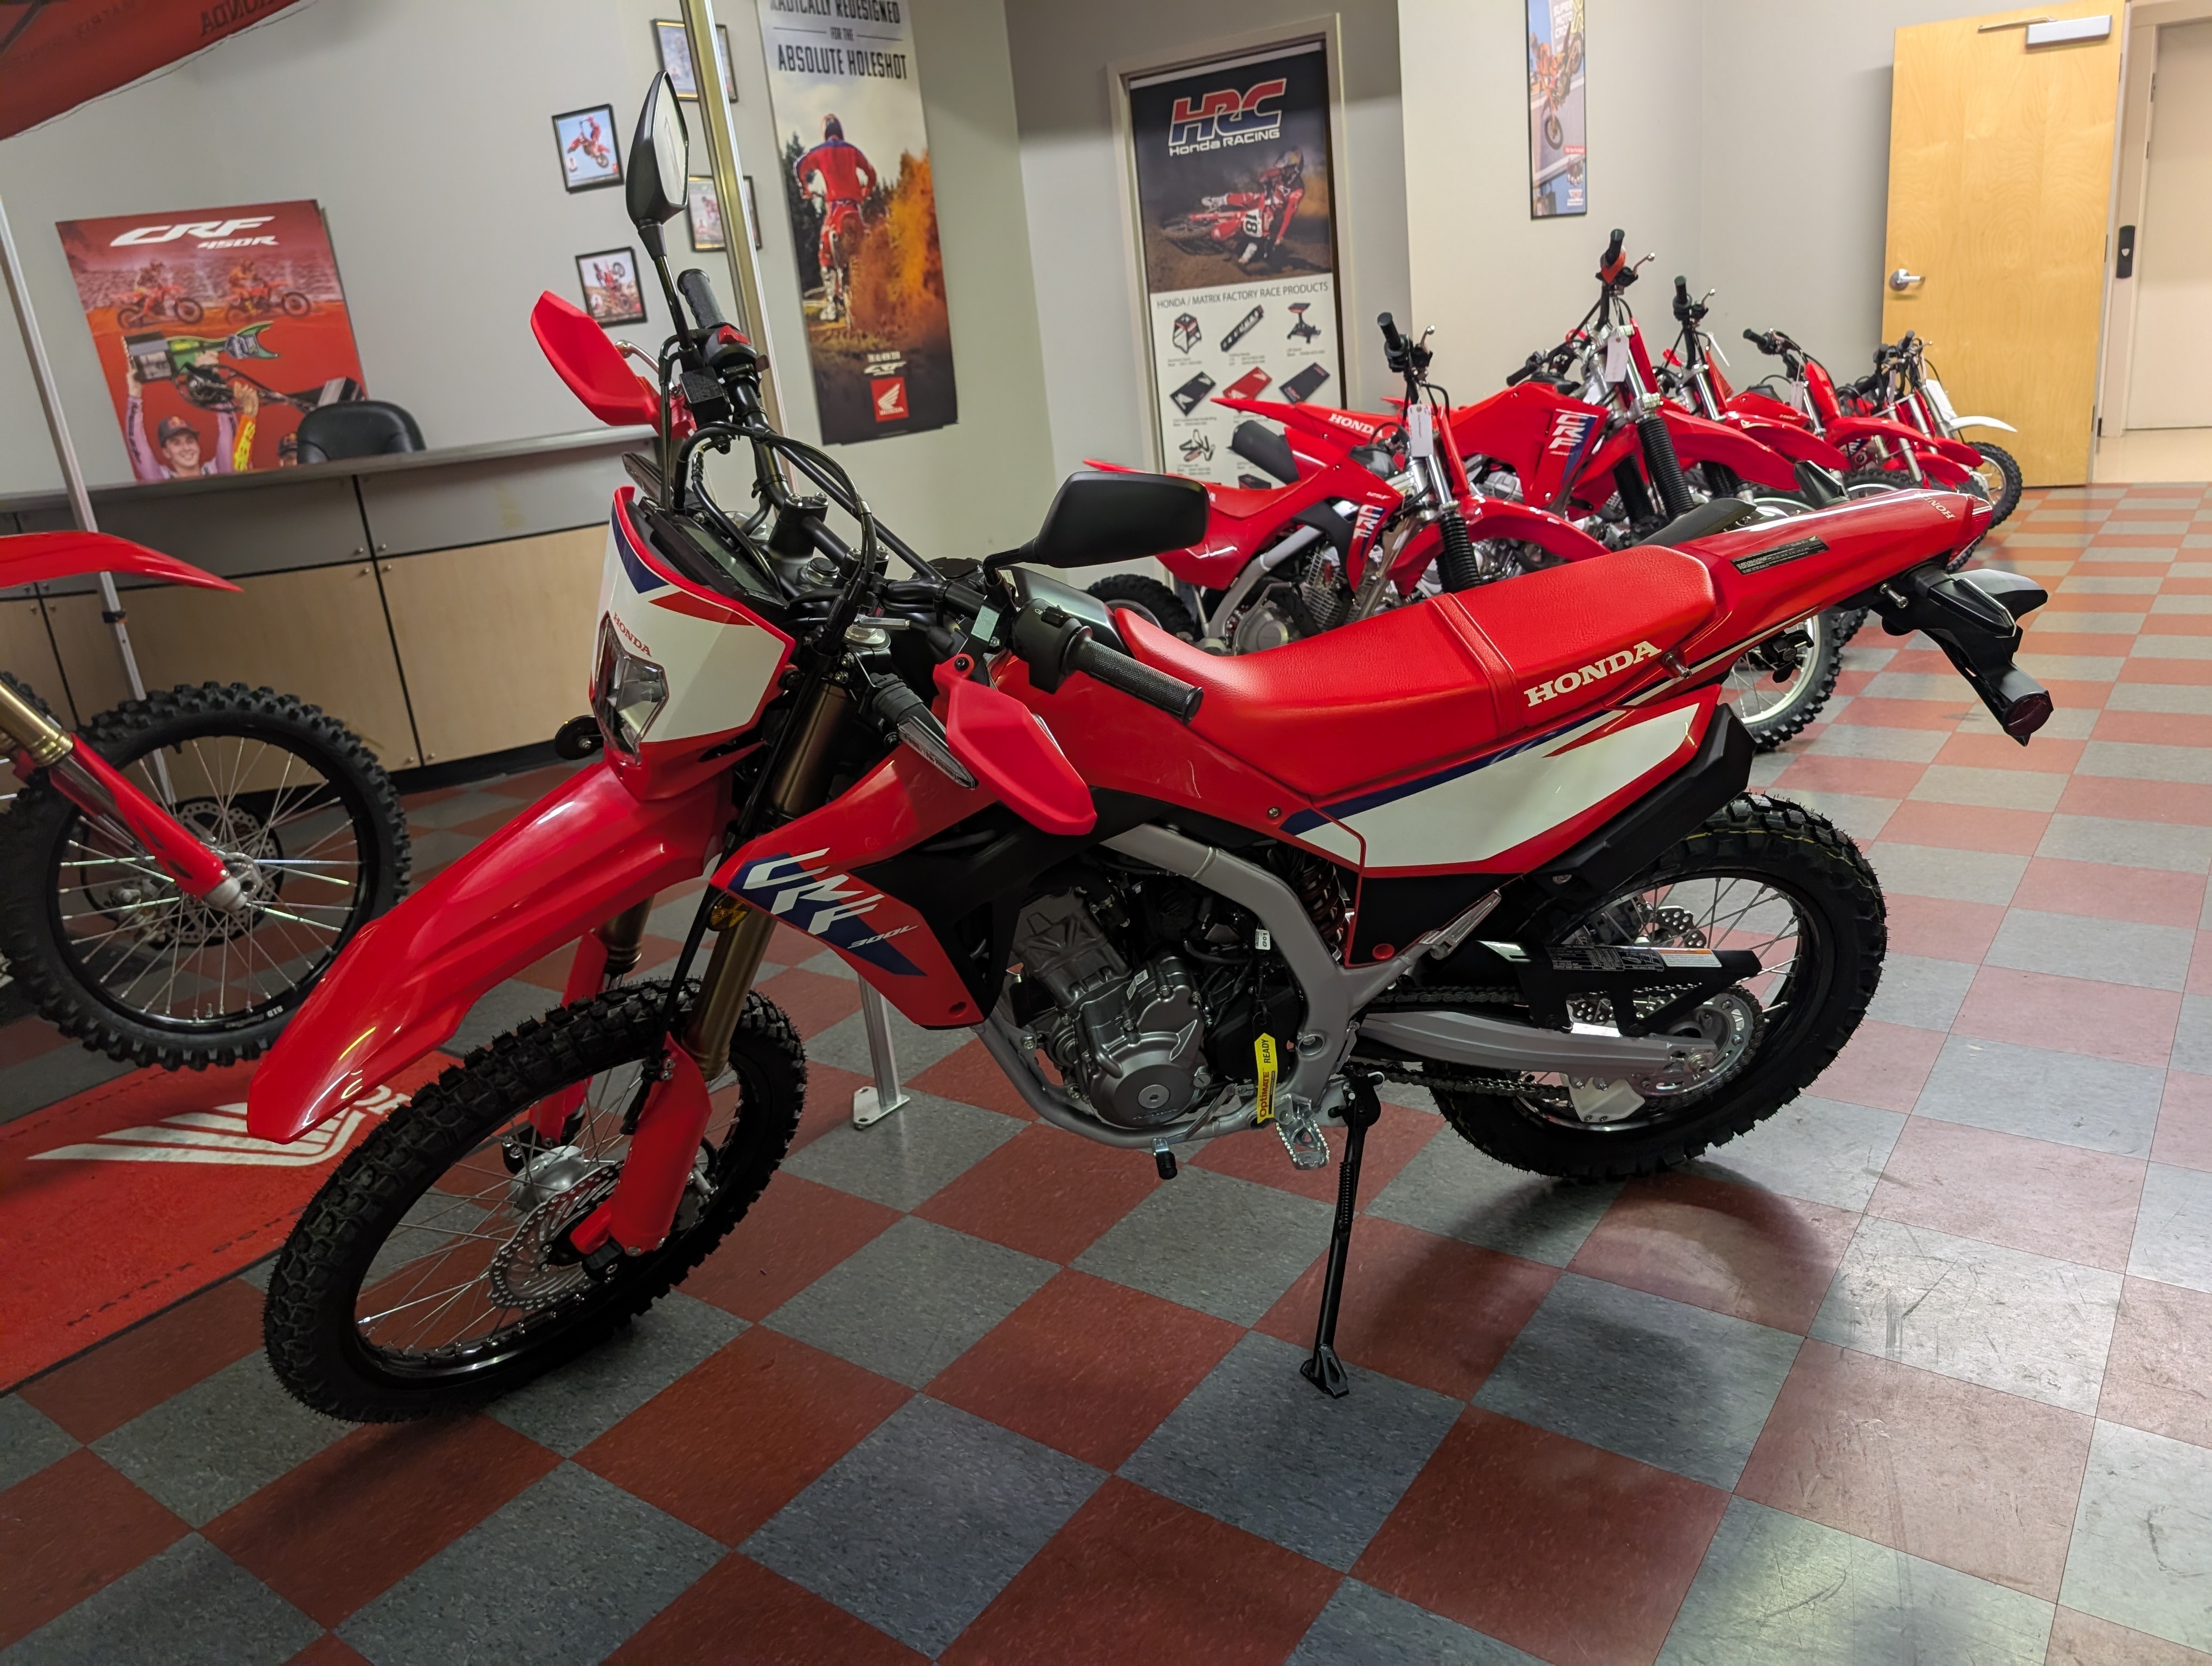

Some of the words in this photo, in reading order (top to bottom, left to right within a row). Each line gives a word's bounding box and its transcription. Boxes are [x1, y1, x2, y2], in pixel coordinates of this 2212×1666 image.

[835, 0, 901, 23] REDESIGNED
[778, 44, 844, 75] ABSOLUTE
[846, 49, 907, 79] HOLESHOT
[1168, 78, 1287, 147] HRC
[1169, 140, 1220, 157] Honda
[1223, 128, 1281, 148] RACING
[110, 216, 275, 247] CRF
[197, 235, 279, 250] 450R
[1156, 297, 1186, 309] HONDA
[1192, 293, 1221, 305] MATRIX
[1222, 289, 1258, 302] FACTORY
[1260, 287, 1280, 297] RACE
[1283, 282, 1329, 295] PRODUCTS
[1548, 413, 1589, 449] CRF
[1921, 495, 1956, 520] HON
[613, 612, 652, 658] HONDA
[1523, 640, 1662, 707] HONDA
[743, 847, 885, 935] CRF
[847, 925, 918, 949] 300L
[1261, 1039, 1271, 1063] READY
[1259, 1071, 1269, 1118] OptiMATE
